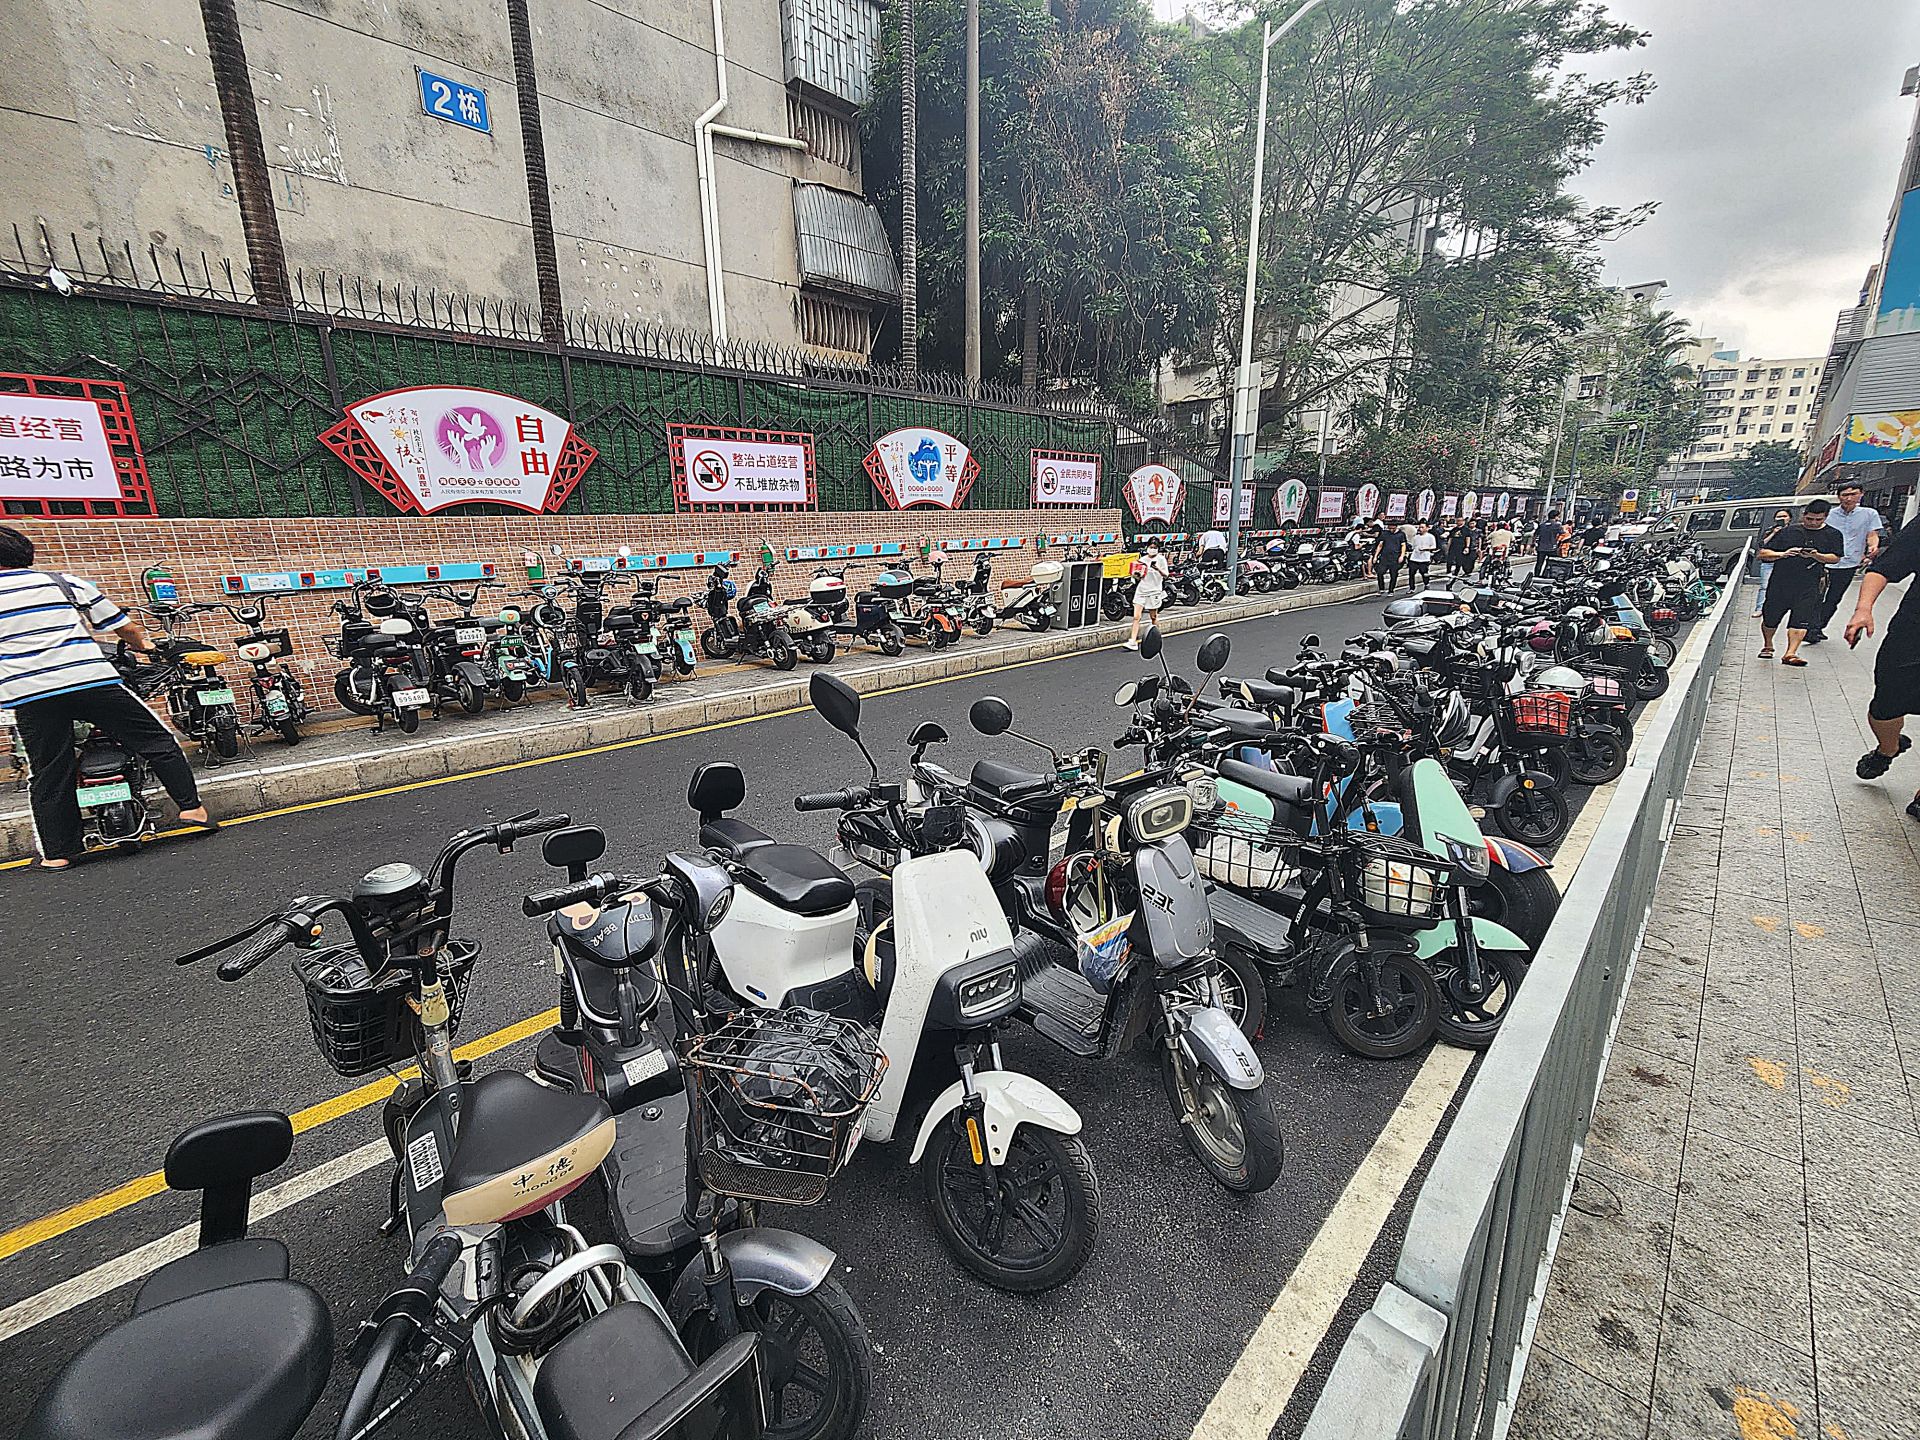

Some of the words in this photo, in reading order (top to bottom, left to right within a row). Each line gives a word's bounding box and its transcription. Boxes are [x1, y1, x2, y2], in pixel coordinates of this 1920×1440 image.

[431, 81, 482, 124] 2栋
[515, 413, 550, 476] 自由
[732, 453, 798, 469] 整治占道经营
[944, 444, 958, 483] 平等
[734, 477, 800, 492] 不乱堆放杂物
[591, 922, 618, 947] BEAR
